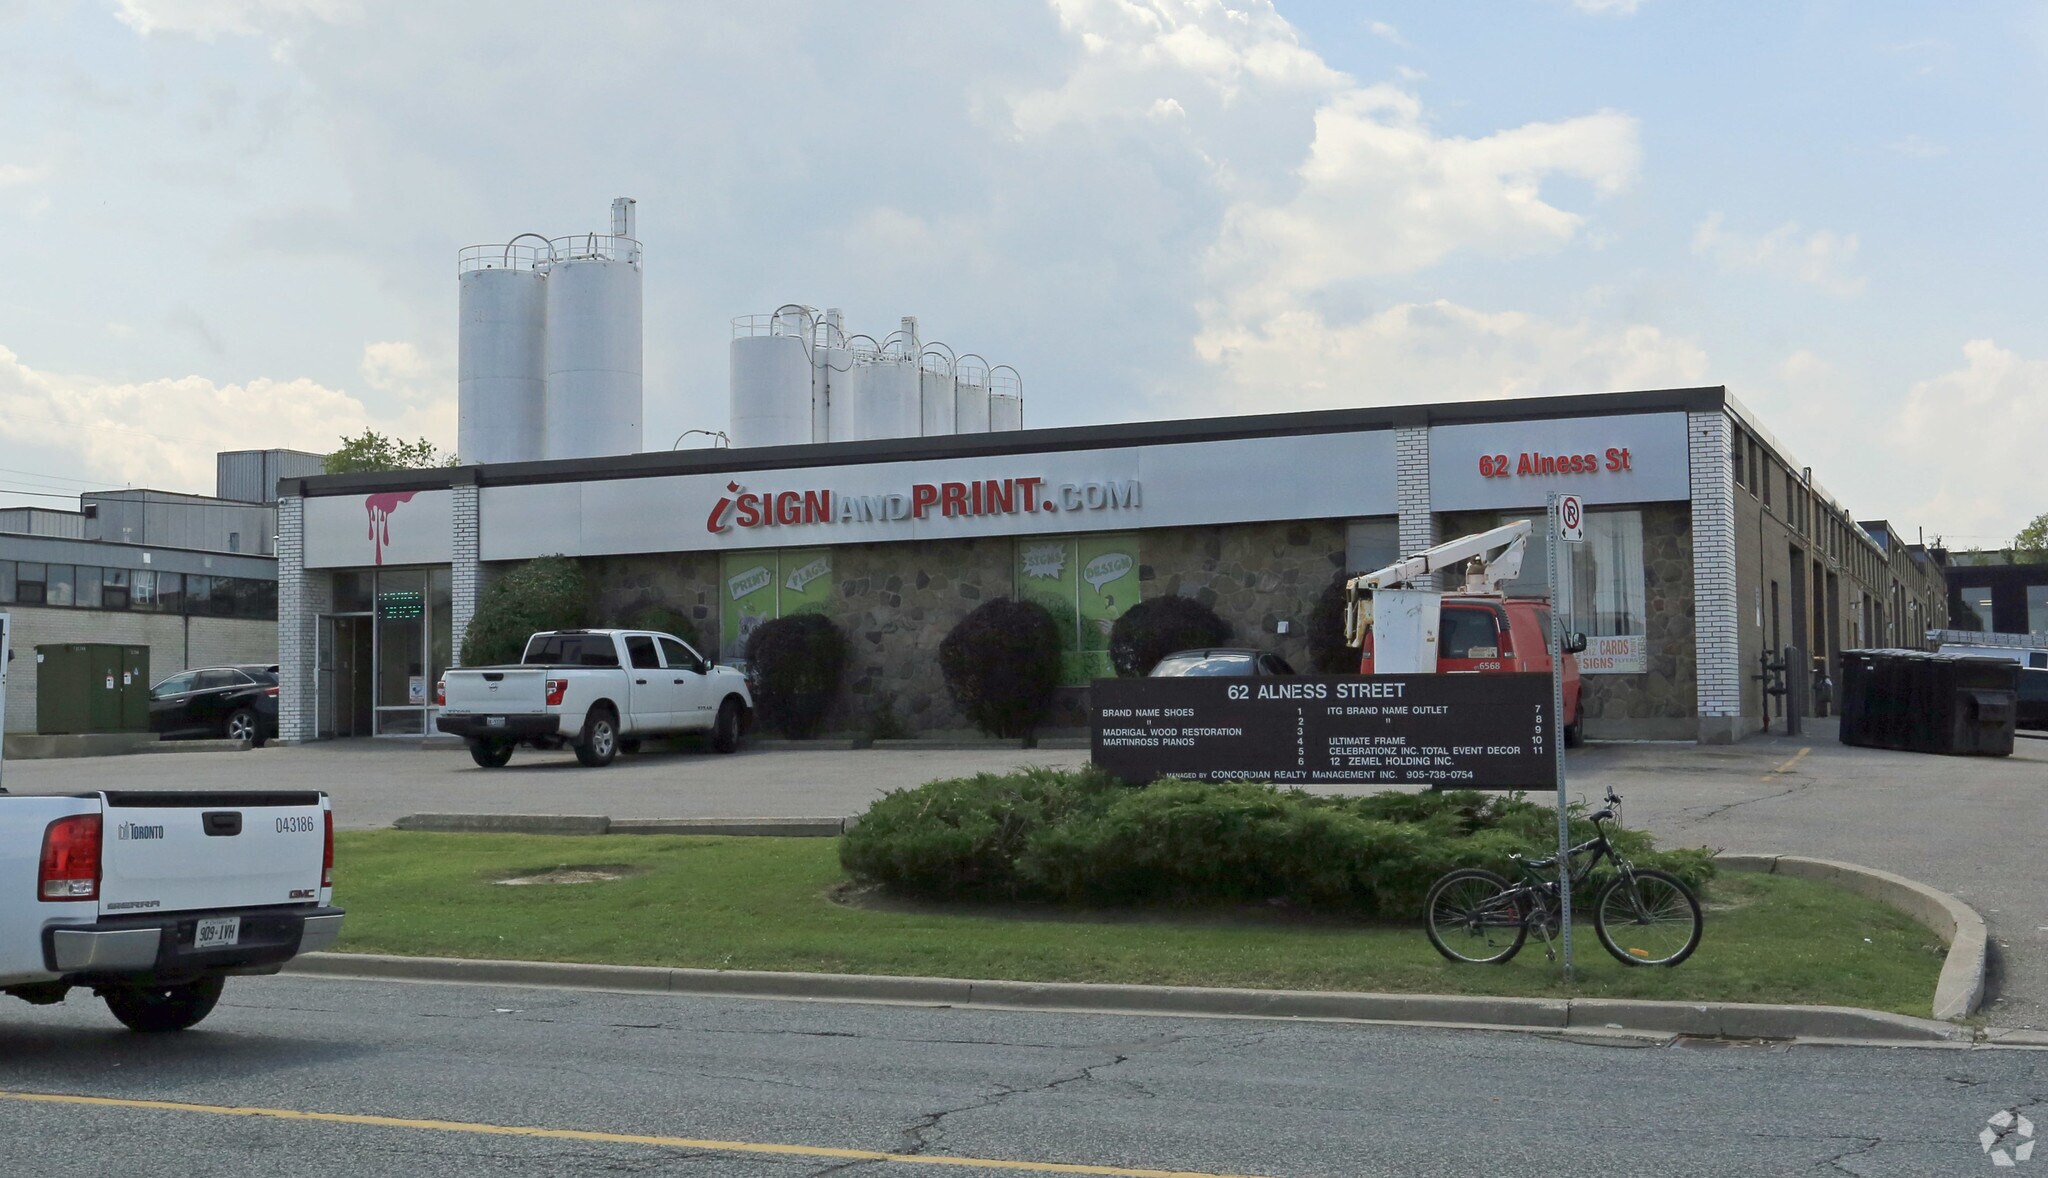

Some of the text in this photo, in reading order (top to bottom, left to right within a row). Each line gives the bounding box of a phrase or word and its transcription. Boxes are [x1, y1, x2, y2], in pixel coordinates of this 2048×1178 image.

[1479, 447, 1631, 477] 62 Alness St
[1086, 557, 1131, 580] DESIGN
[792, 562, 827, 586] FLAGS
[731, 570, 767, 595] PRINT
[1600, 639, 1629, 655] CARDS
[1479, 662, 1501, 670] 6568
[1583, 657, 1614, 669] SIGNS
[1228, 682, 1405, 700] 62 ALNESS STREET
[1103, 708, 1194, 717] BRAND NAME SHOES
[1297, 707, 1302, 715] 1
[1327, 706, 1448, 715] ITG BRAND NAME OUTLET
[1535, 705, 1541, 713] 7
[1298, 717, 1304, 726] 2
[1536, 715, 1542, 723] 8
[1103, 728, 1242, 736] MADRIGAL WOOD RESTORATION
[1297, 727, 1303, 735] 3
[1535, 725, 1542, 734] 9
[1103, 738, 1195, 746] MARTINROSS PIANOS
[1297, 737, 1303, 745] 4
[1329, 737, 1406, 745] ULTIMATE FRAME
[1532, 736, 1542, 744] 10
[1298, 747, 1304, 755] 5
[1329, 746, 1521, 755] CELEBRATIONZ INC. TOTAL EVENT DECOR
[1533, 746, 1543, 754] 11
[1298, 757, 1304, 765] 6
[1330, 757, 1455, 765] 12 ZEMEL HOLDING INC.
[1211, 770, 1271, 779] CONCORDIAN
[1274, 770, 1307, 779] REALTY
[1312, 771, 1376, 779] MANAGEMENT
[1379, 771, 1398, 779] INC.
[1406, 771, 1473, 779] 905-738-0754
[275, 816, 314, 834] 043186
[129, 823, 164, 840] TORONTO
[289, 889, 315, 899] GMC
[107, 900, 160, 910] SIERRA
